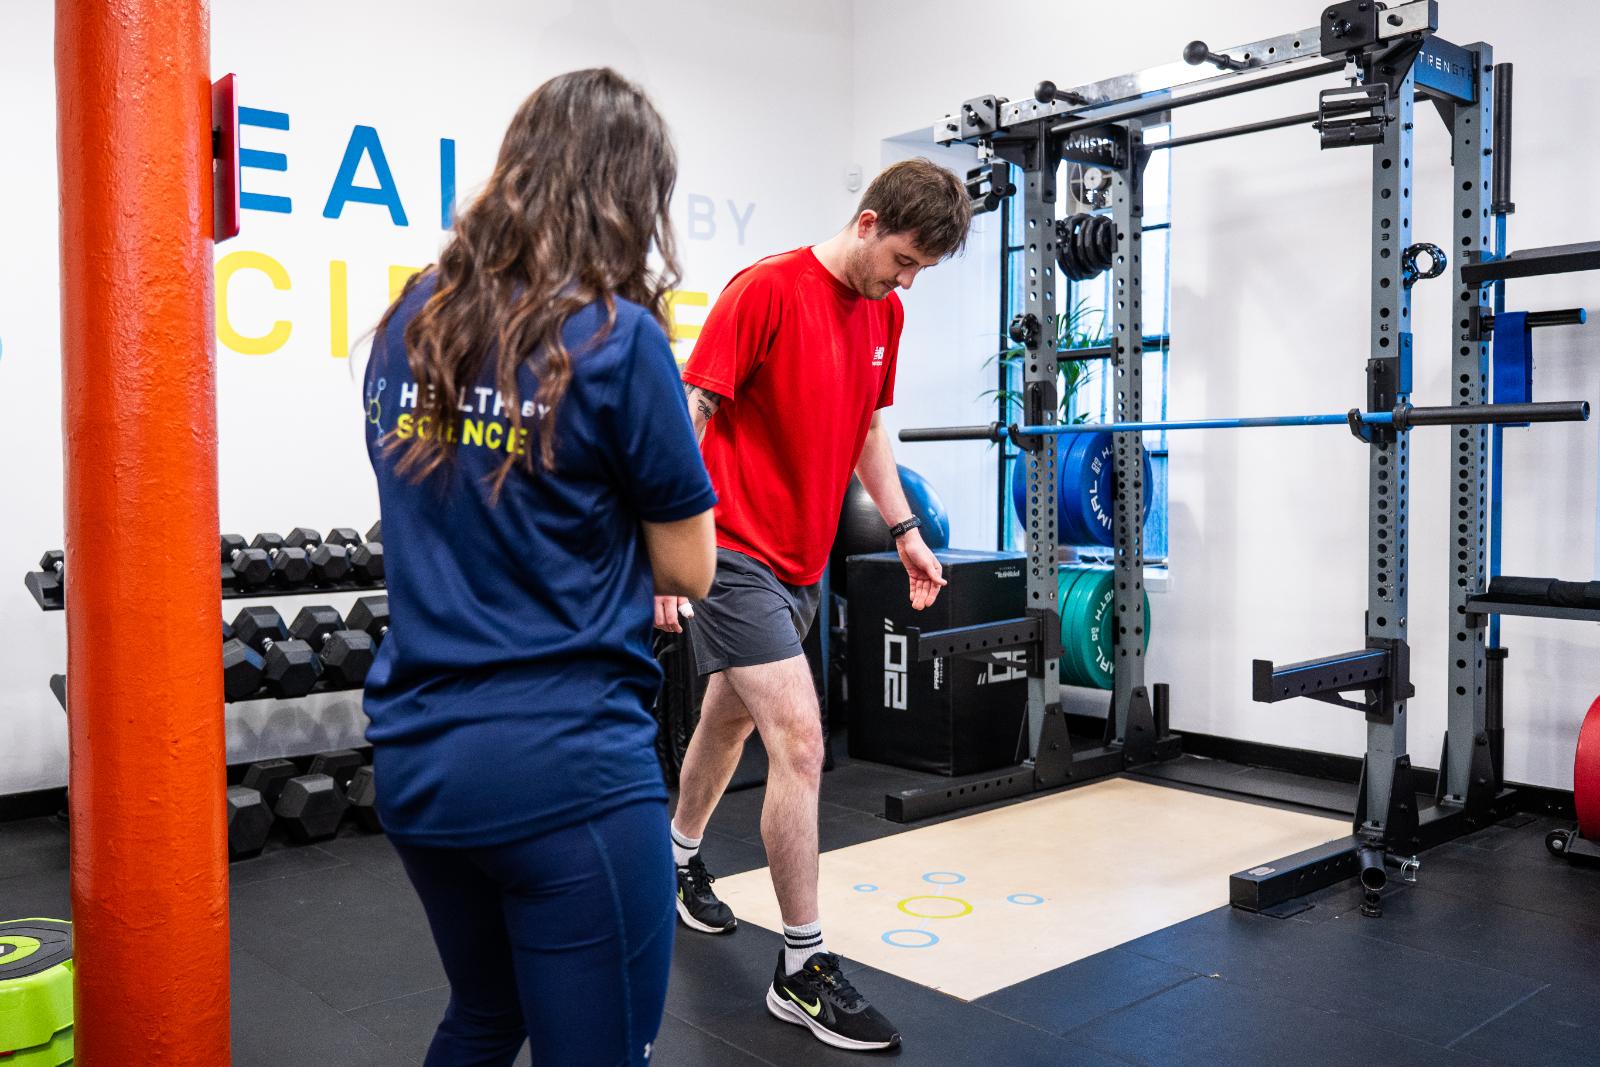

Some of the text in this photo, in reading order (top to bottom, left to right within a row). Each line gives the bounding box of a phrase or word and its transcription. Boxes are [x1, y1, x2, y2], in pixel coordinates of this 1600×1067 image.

[1419, 51, 1473, 80] TRENGTH
[688, 193, 757, 246] BY
[400, 382, 551, 420] HELTH BY
[1089, 480, 1112, 531] IMAL
